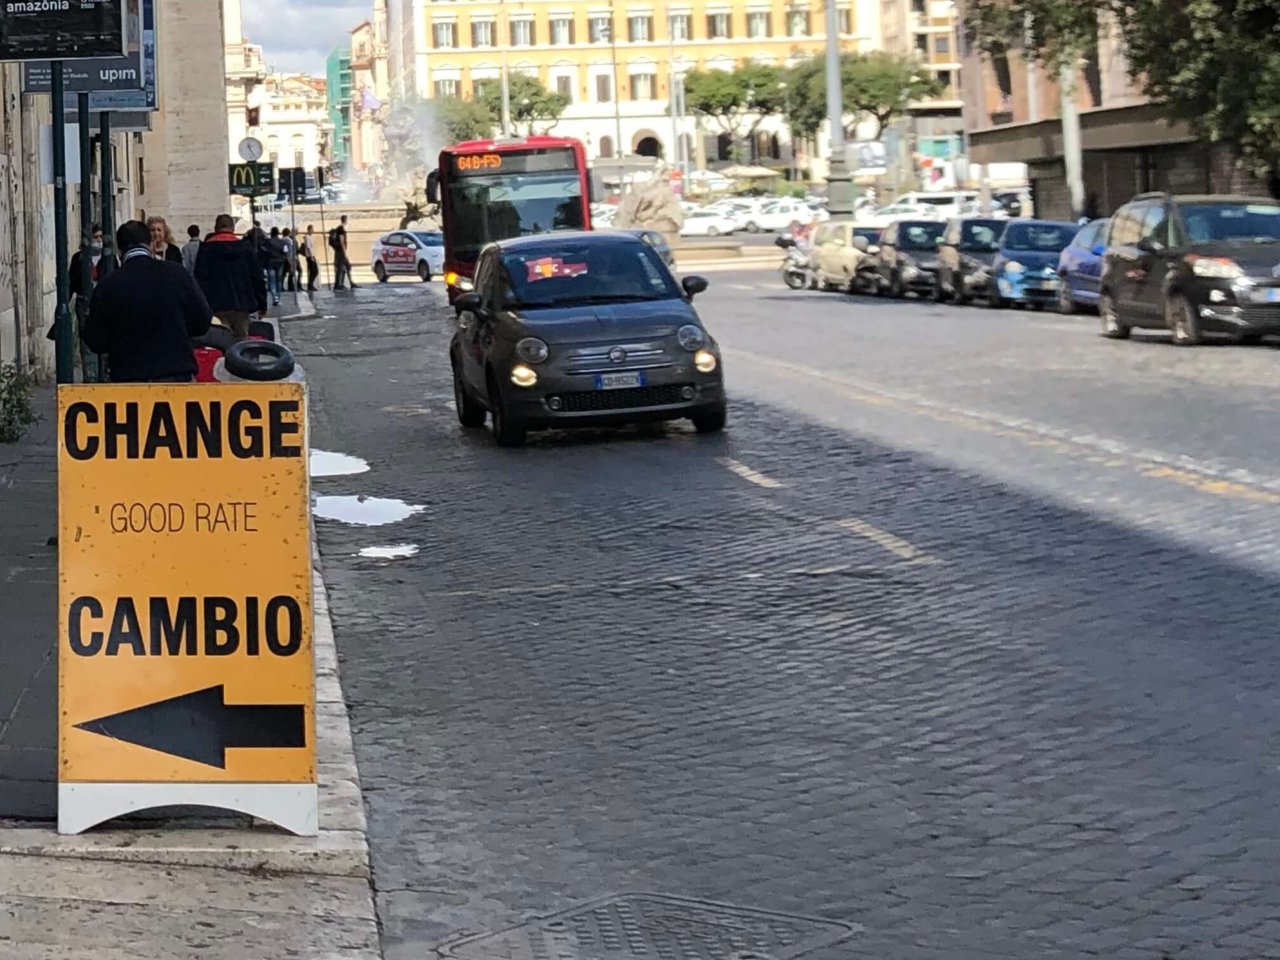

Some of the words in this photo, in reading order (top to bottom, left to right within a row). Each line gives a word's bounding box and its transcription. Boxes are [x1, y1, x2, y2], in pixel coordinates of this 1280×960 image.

[6, 0, 69, 12] amazônia
[99, 68, 137, 83] upim
[64, 399, 302, 461] CHANGE
[110, 502, 185, 533] GOOD
[195, 502, 259, 533] RATE
[68, 595, 303, 657] CAMBIO
